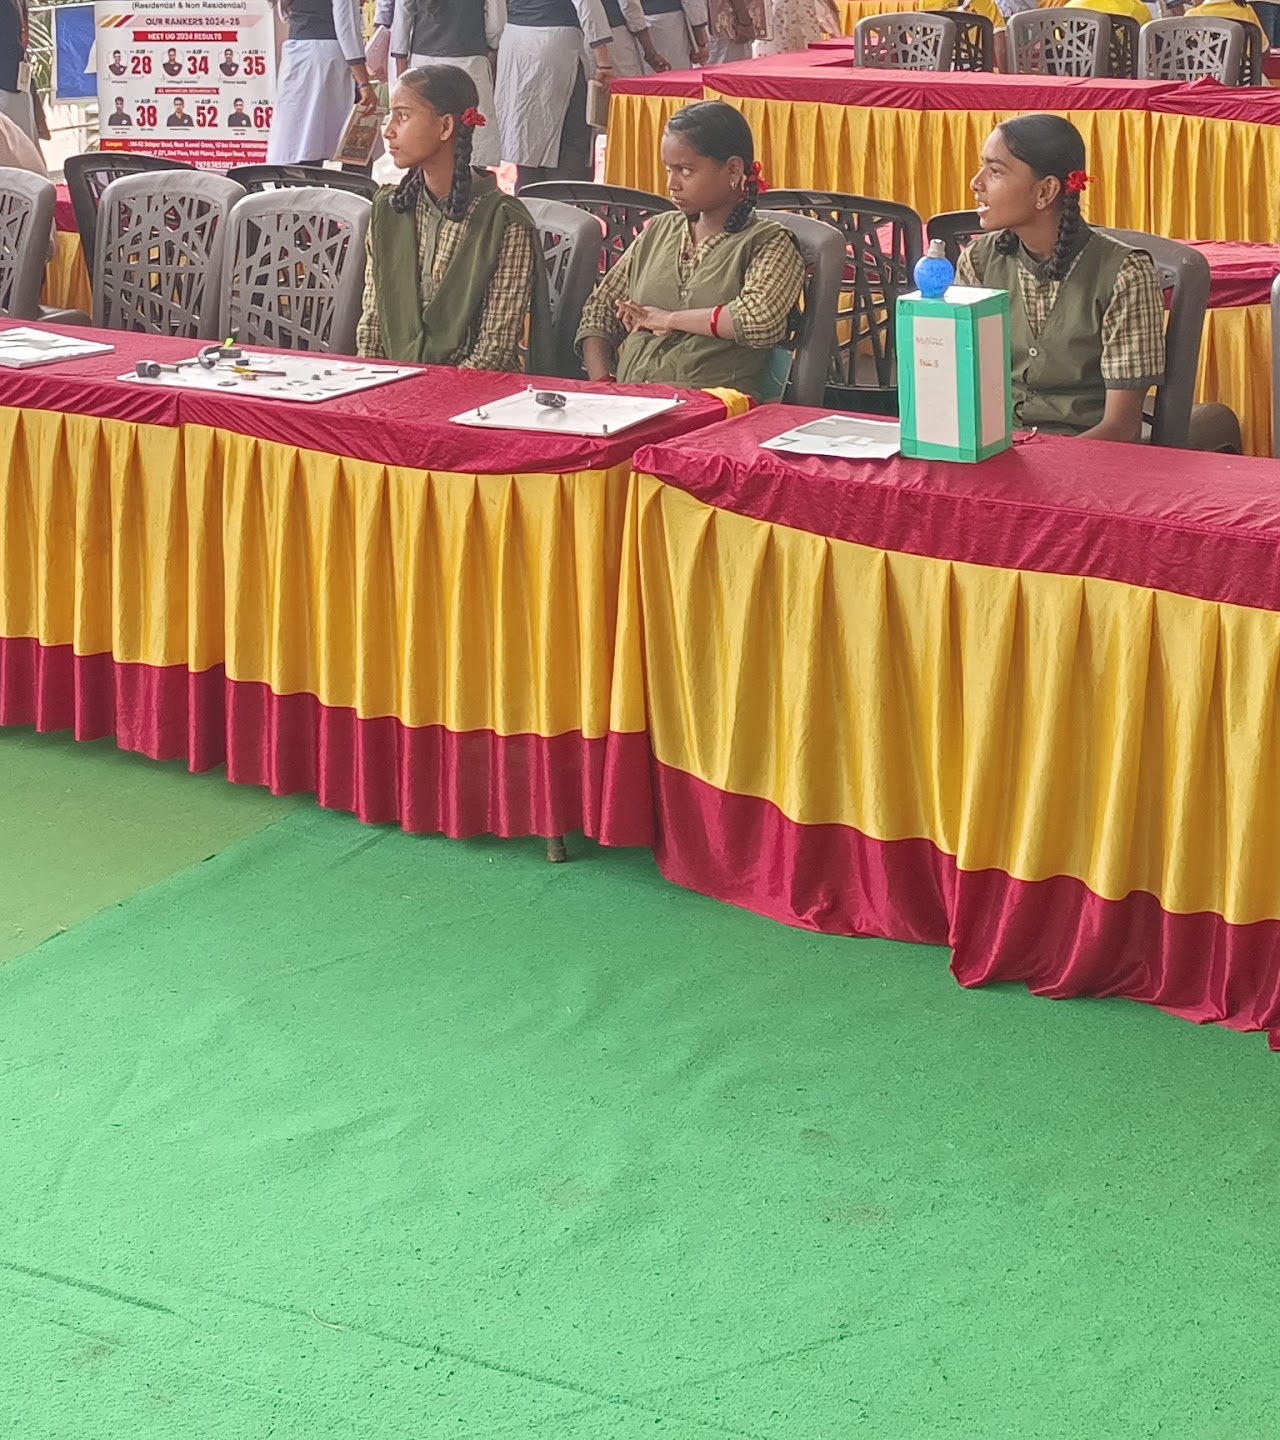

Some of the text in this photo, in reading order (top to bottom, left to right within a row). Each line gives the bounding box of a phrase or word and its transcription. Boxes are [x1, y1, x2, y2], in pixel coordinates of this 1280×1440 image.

[132, 2, 175, 10] (Residential
[202, 1, 247, 10] Residential)
[205, 17, 240, 25] 2024-25
[131, 56, 266, 76] 28 34 35
[136, 106, 157, 127] 38
[196, 105, 218, 127] 52
